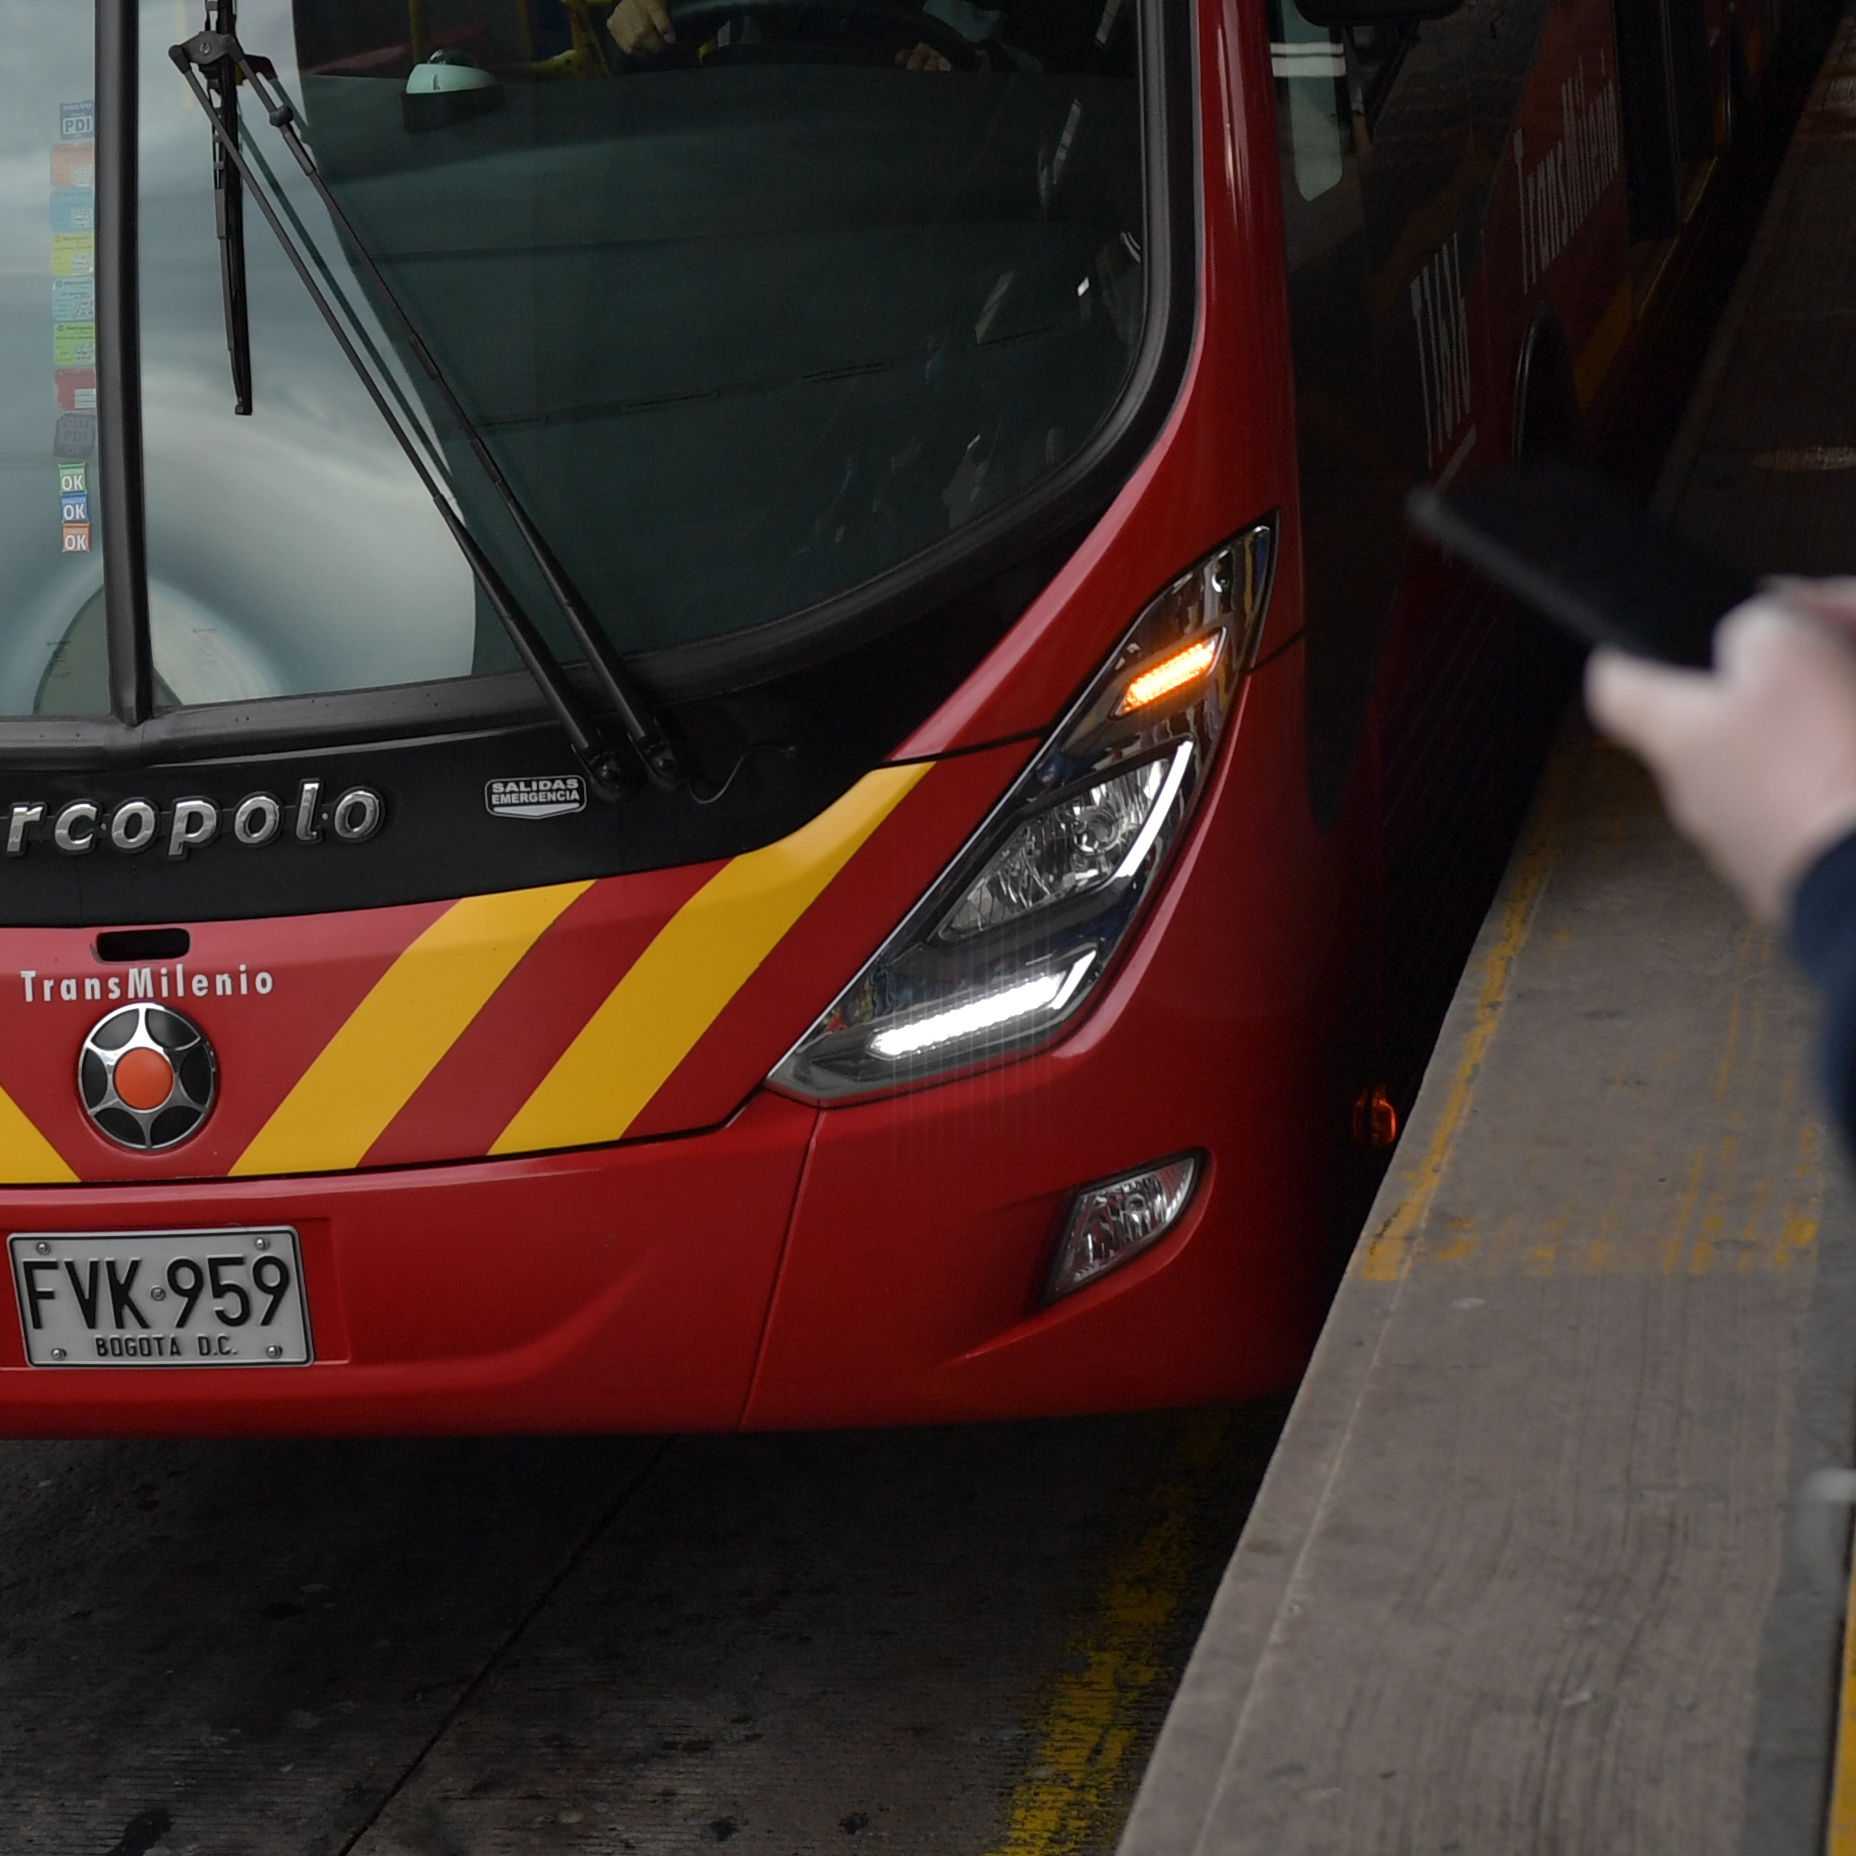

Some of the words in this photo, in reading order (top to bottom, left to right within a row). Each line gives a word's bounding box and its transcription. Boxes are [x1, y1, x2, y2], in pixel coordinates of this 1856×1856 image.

[64, 117, 91, 133] PDI
[61, 474, 84, 491] OK
[63, 503, 86, 521] OK
[64, 534, 87, 551] OK
[491, 778, 580, 793] SALIDAS
[491, 790, 581, 805] EMERGENCIA
[19, 963, 274, 1003] TransMilenio
[94, 1334, 182, 1357] BOGOTA
[197, 1333, 239, 1356] D.C.
